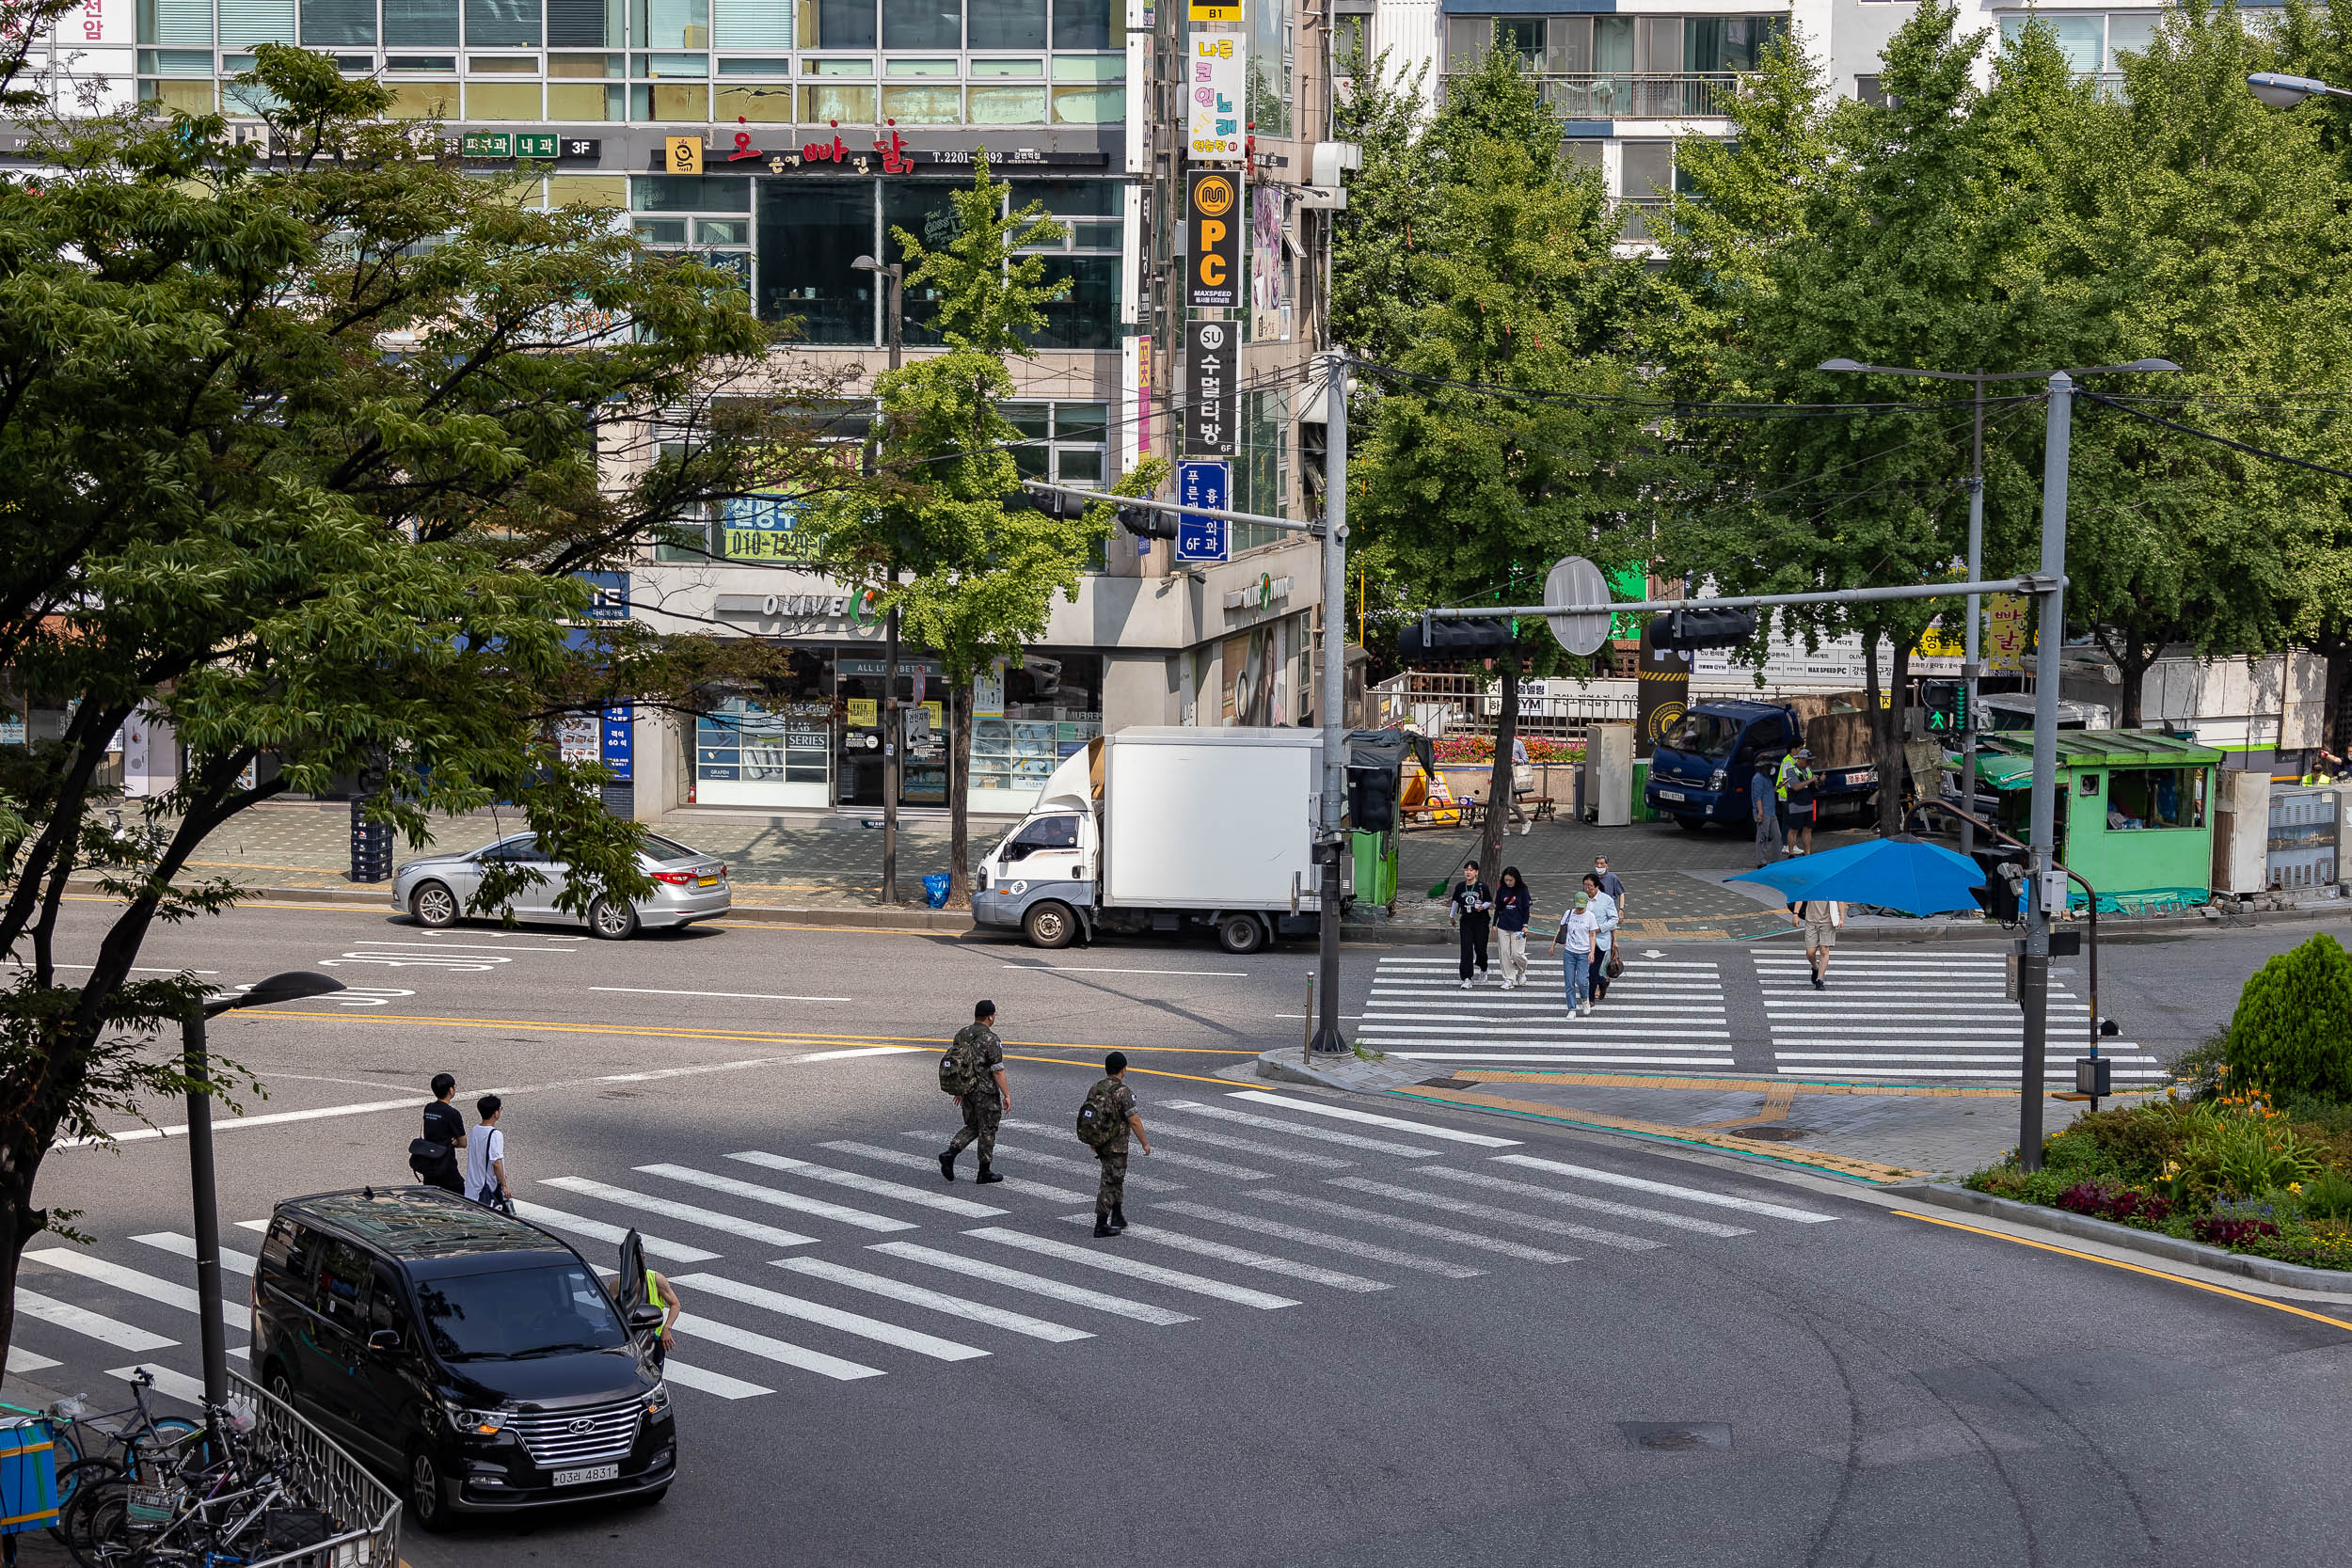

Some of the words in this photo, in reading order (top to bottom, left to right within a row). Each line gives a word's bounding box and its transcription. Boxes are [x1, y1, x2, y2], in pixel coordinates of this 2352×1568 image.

[1209, 9, 1222, 18] B1
[1198, 40, 1233, 59] 나루
[1195, 62, 1214, 107] 코인
[1216, 92, 1237, 135] 노래
[571, 142, 590, 154] 3F
[1202, 330, 1222, 344] SU
[1200, 354, 1221, 445] 수멀티방
[1220, 444, 1232, 452] 6F
[1205, 488, 1218, 552] 흉외과
[1186, 537, 1200, 550] 6F
[761, 594, 844, 617] OLIVE
[788, 735, 825, 746] SERIES
[585, 1466, 612, 1481] 4831
